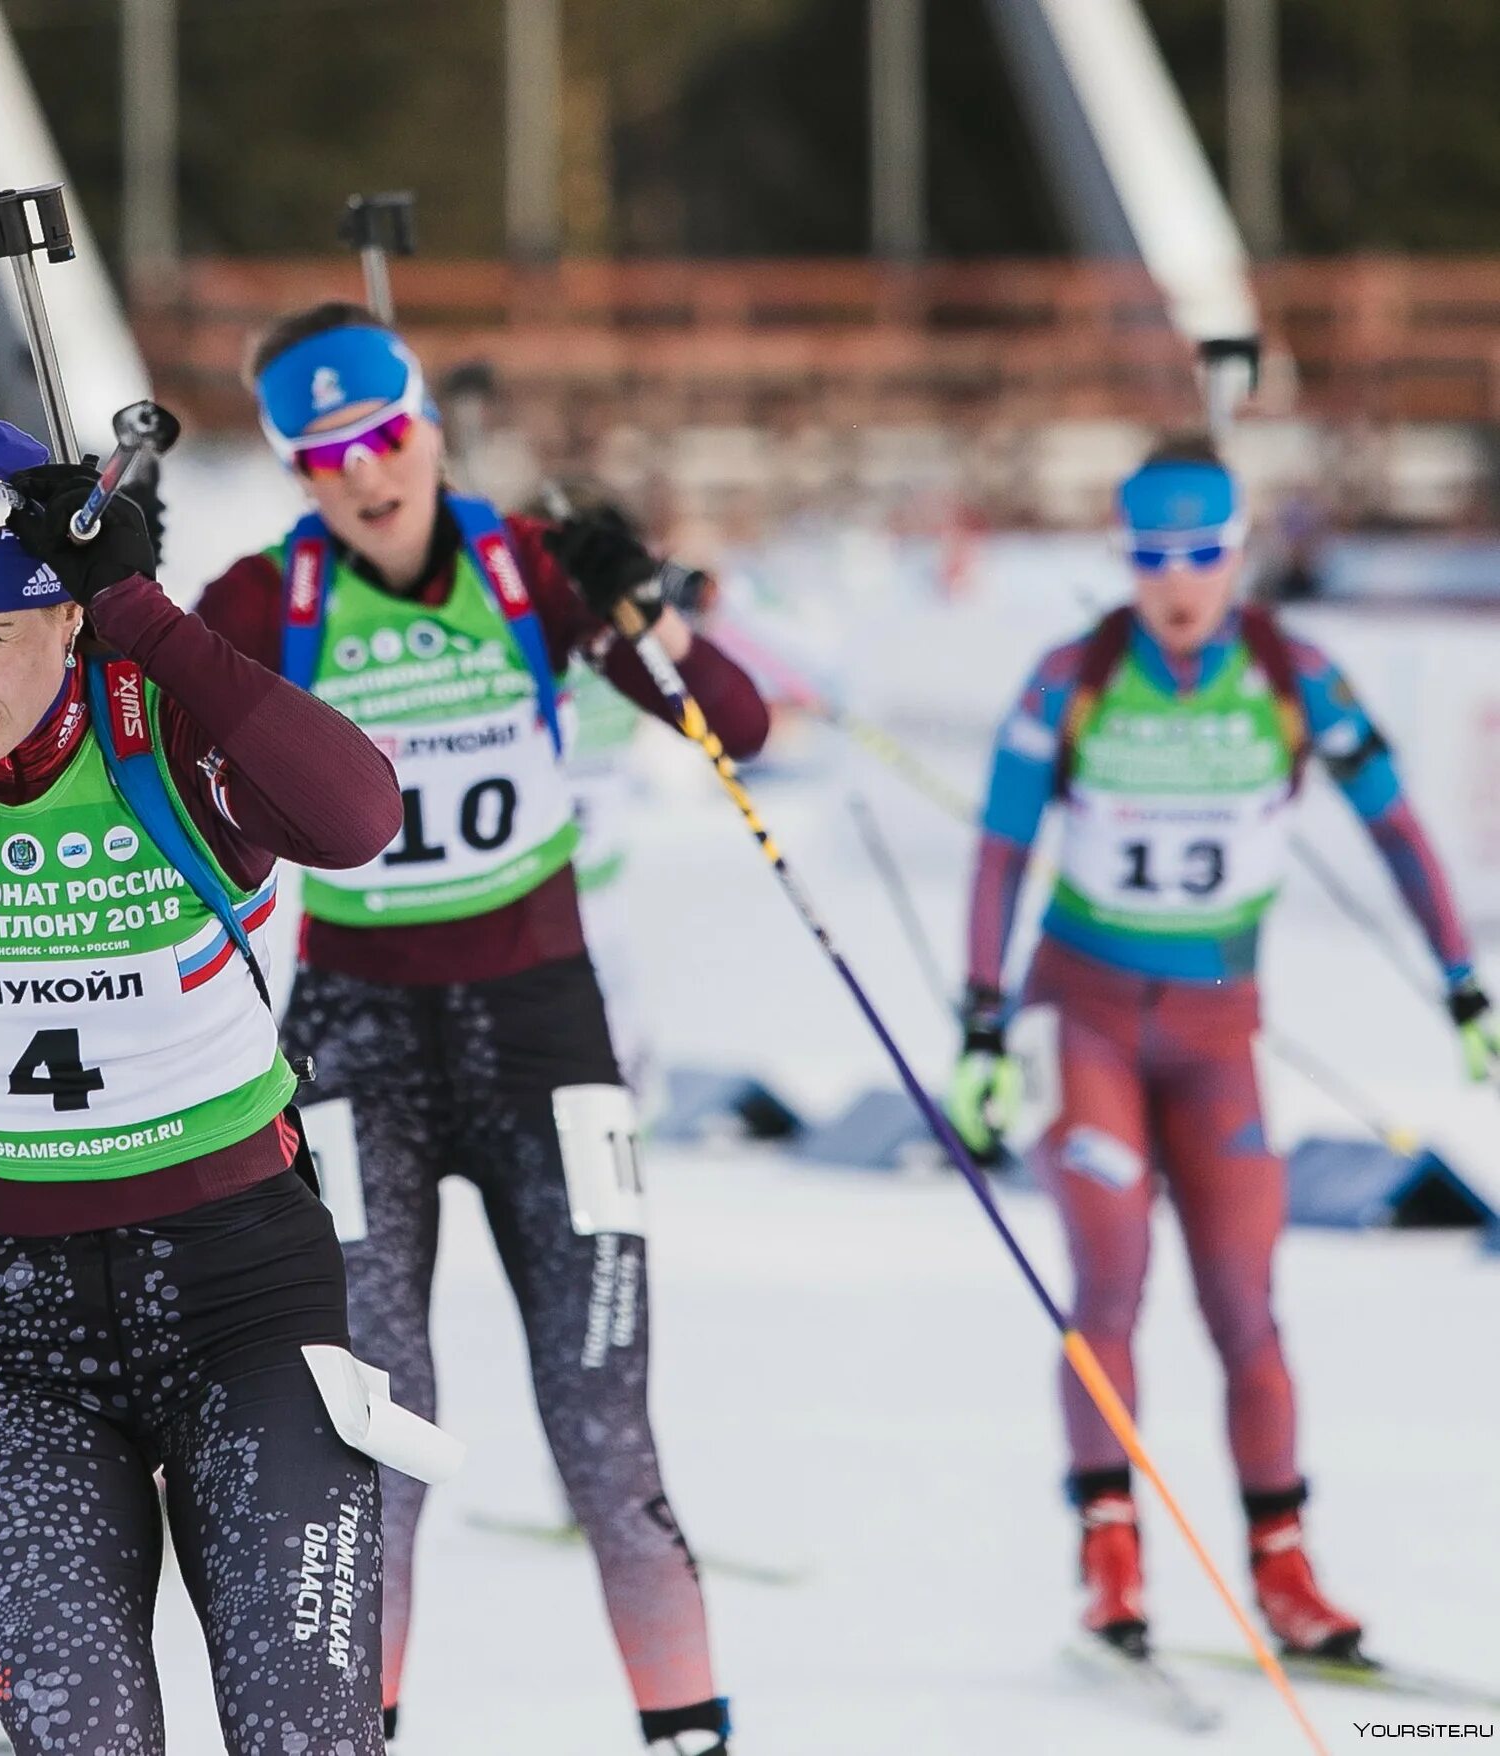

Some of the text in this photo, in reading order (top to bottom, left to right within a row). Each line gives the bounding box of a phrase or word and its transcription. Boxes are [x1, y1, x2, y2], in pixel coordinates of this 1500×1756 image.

[22, 581, 62, 597] adidas
[383, 777, 518, 867] 10
[66, 868, 186, 905] РОССИИ
[1118, 838, 1226, 896] 13
[106, 896, 181, 933] 2018
[49, 943, 80, 955] ЮГРА
[86, 939, 131, 953] РОССИЯ
[7, 1028, 105, 1112] 4
[294, 1522, 329, 1641] ОБЛАСТЬ
[328, 1503, 360, 1669] ТЮМЕНСКАЯ
